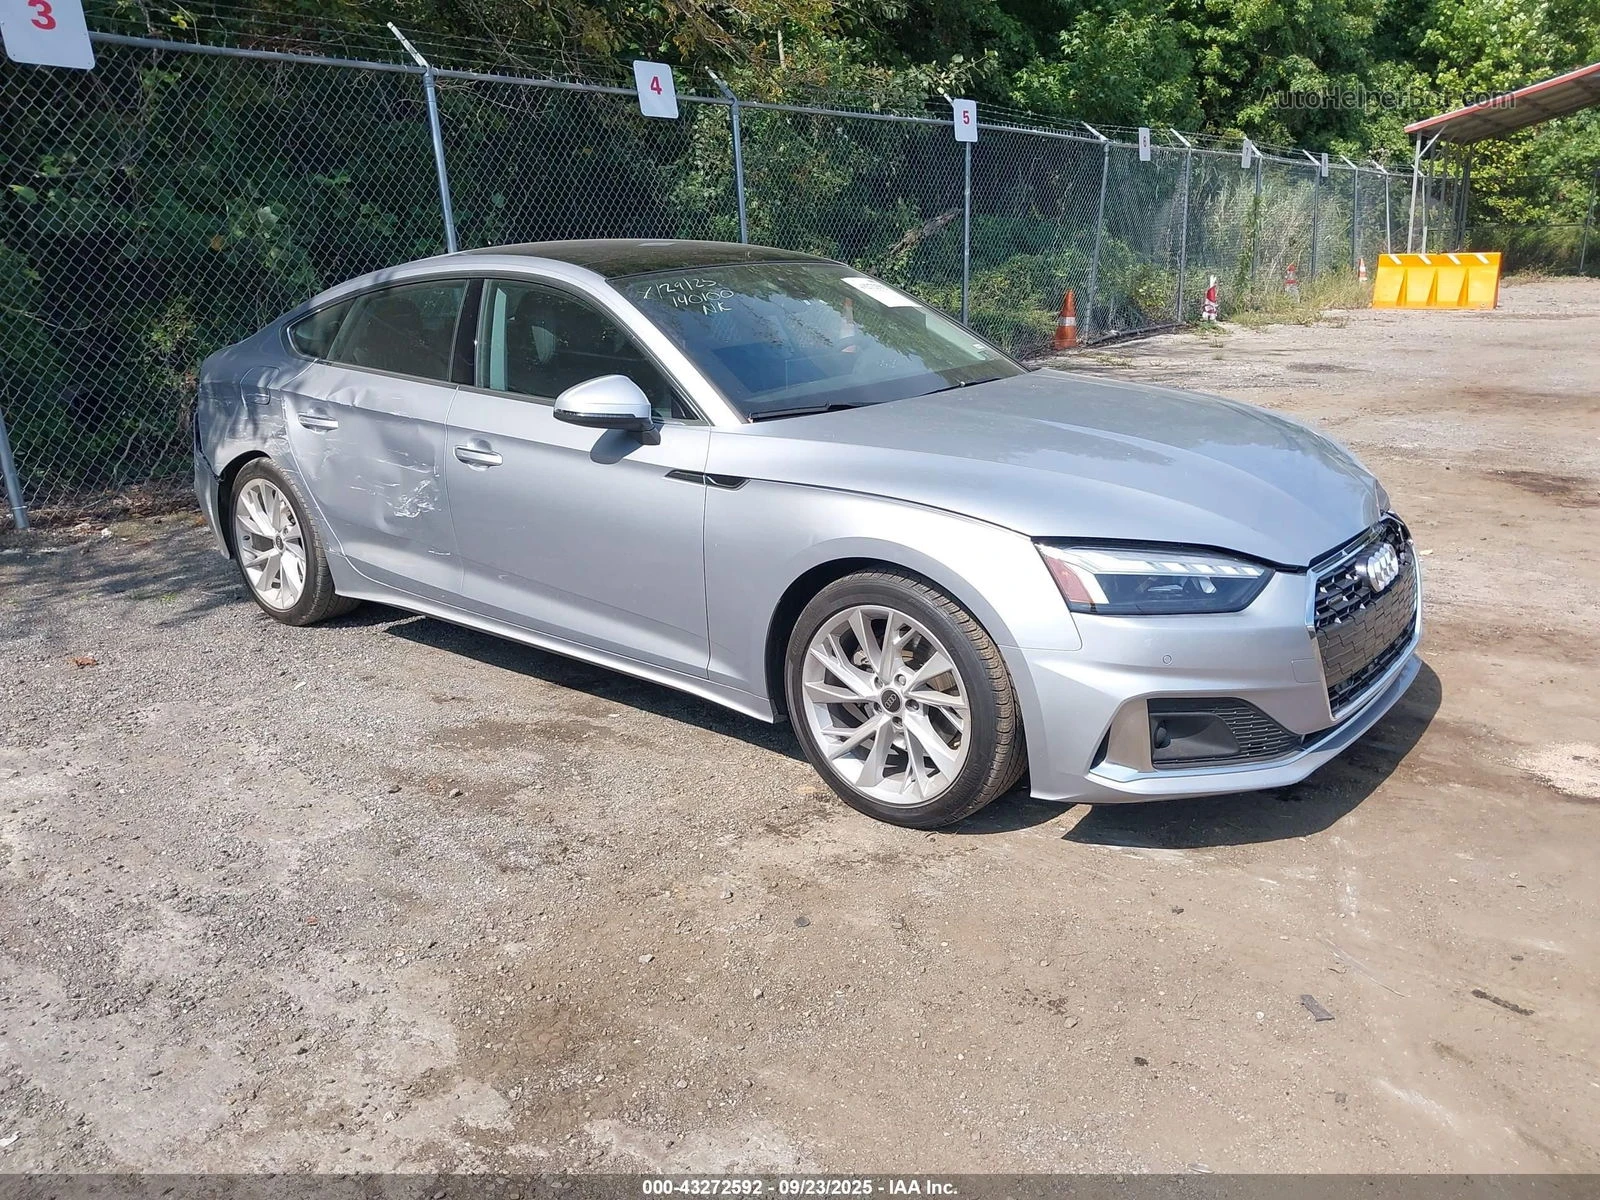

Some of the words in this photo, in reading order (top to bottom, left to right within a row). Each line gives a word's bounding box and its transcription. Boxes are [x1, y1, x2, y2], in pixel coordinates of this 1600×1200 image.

[27, 0, 57, 31] 3
[650, 75, 663, 96] 4
[962, 110, 970, 125] 5
